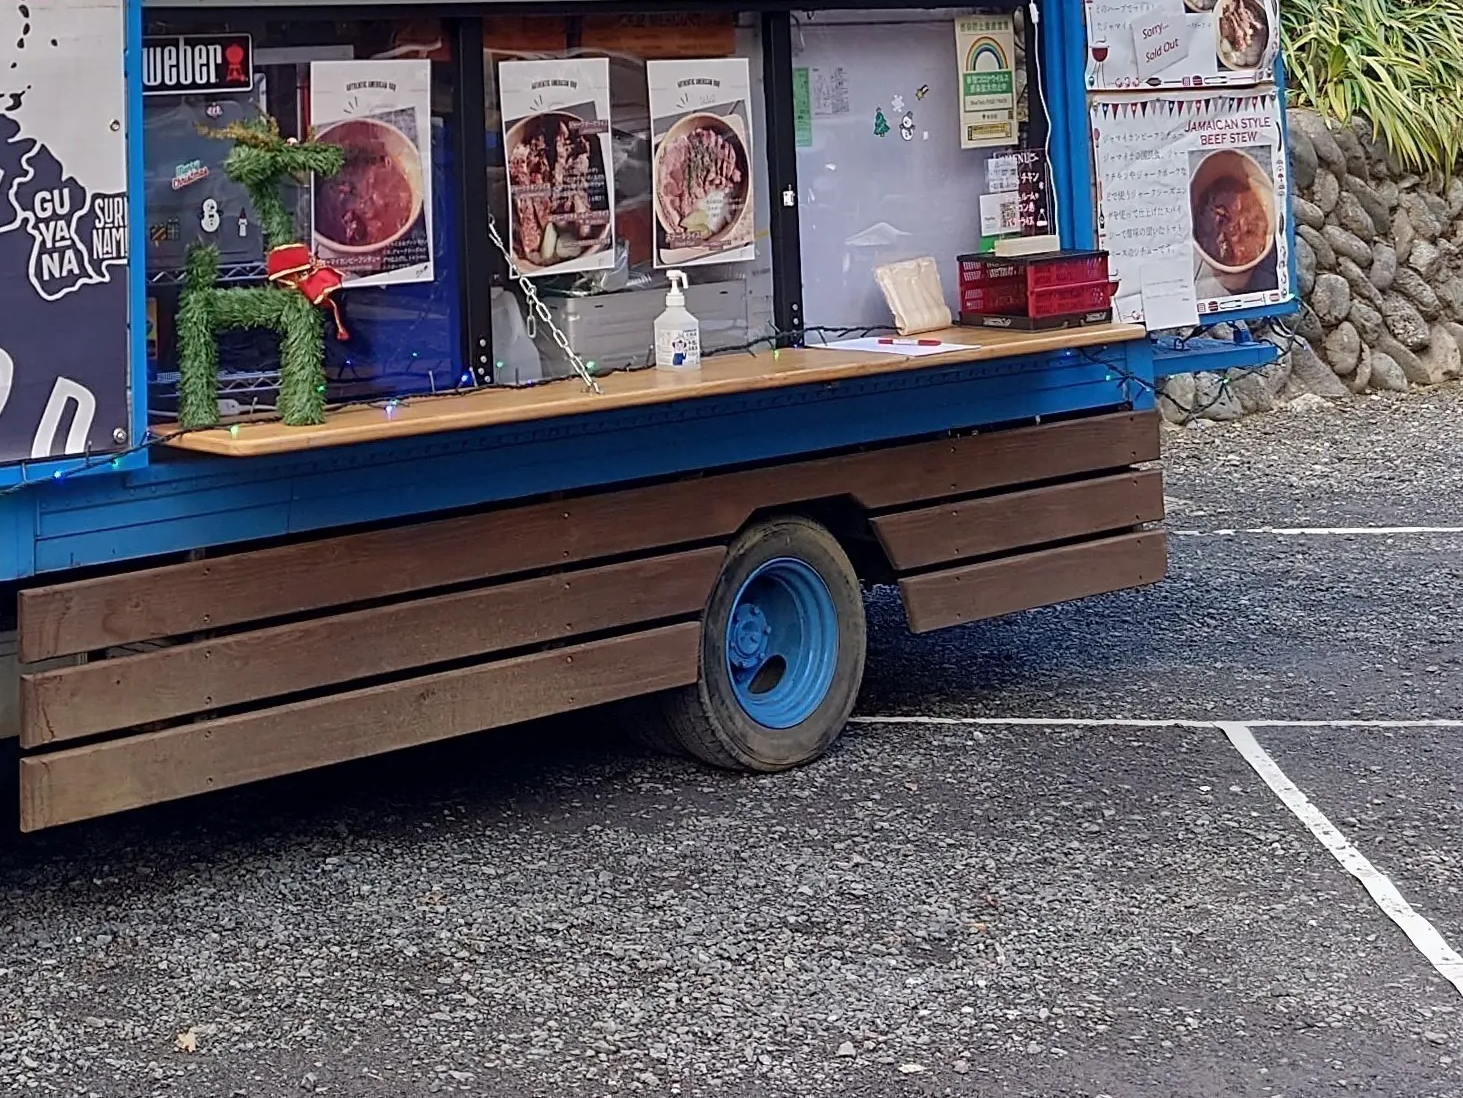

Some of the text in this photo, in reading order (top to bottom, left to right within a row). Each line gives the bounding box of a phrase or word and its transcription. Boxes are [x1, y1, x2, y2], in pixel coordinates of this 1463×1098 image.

[143, 38, 222, 86] weber
[1145, 38, 1179, 64] Sold Out
[1185, 117, 1271, 133] JAMAICAN STYLE
[1200, 131, 1258, 146] BEEF STEW
[34, 188, 70, 218] GU
[38, 220, 72, 248] YA
[42, 249, 80, 281] NA
